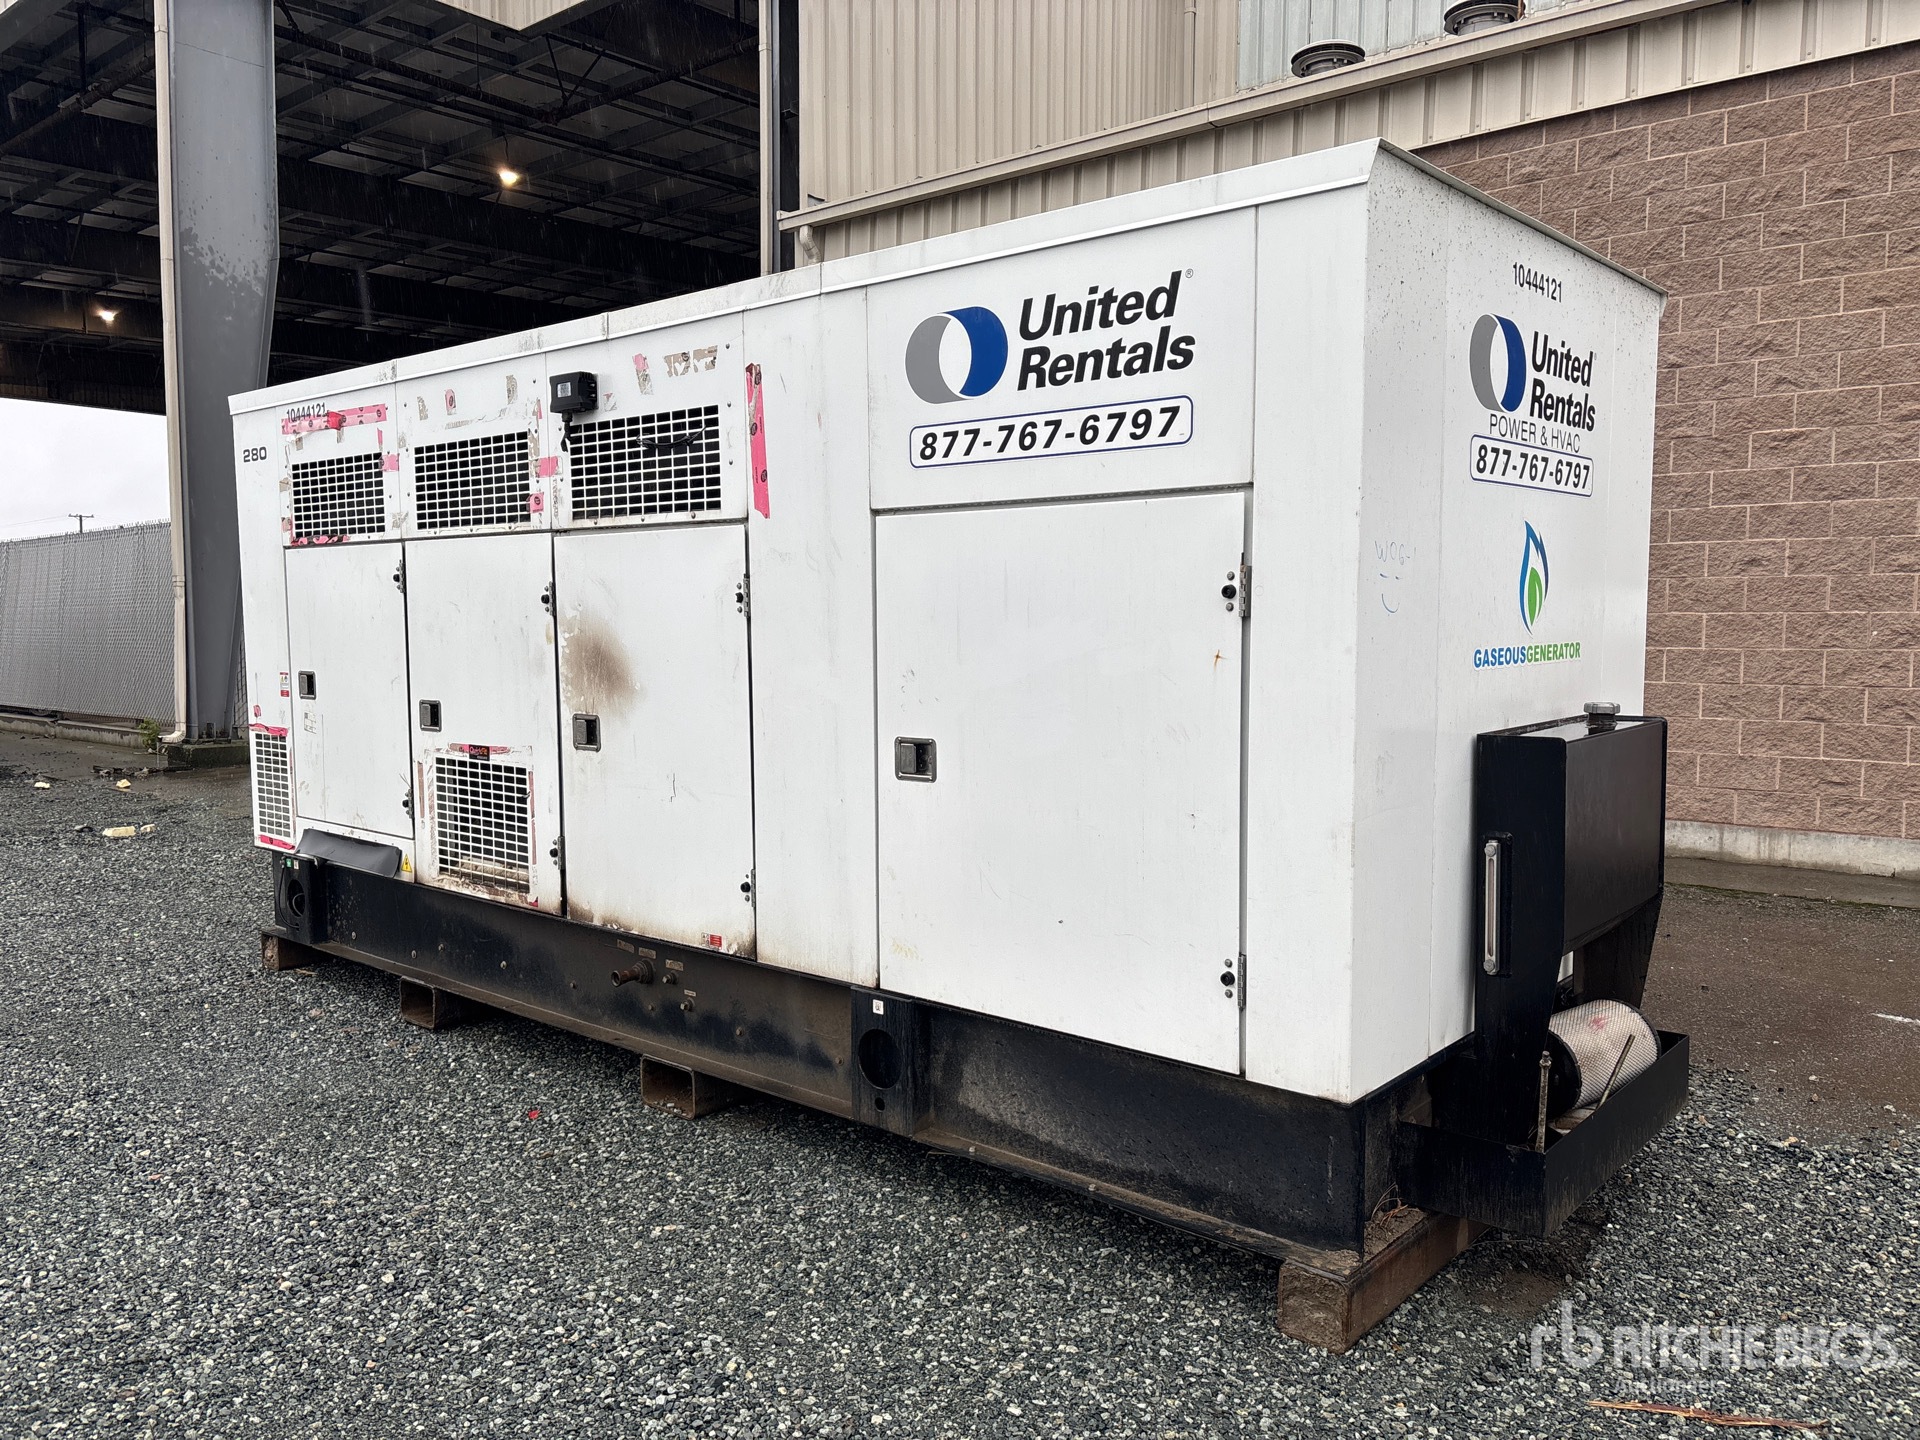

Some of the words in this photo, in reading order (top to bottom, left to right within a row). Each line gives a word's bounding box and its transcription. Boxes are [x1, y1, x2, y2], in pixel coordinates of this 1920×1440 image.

[1018, 269, 1182, 341] United
[1512, 261, 1562, 303] 10444121
[1017, 325, 1196, 391] Rentals
[1531, 331, 1594, 387] United
[1529, 377, 1596, 432] Rentals
[242, 446, 268, 463] 280
[919, 405, 1181, 460] 877-767-6797
[1489, 413, 1537, 444] POWER
[1540, 425, 1549, 446] &
[1551, 432, 1581, 454] HVAC
[1476, 444, 1591, 490] 877-767-6797
[1473, 641, 1581, 668] GASEOUSGENERATOR
